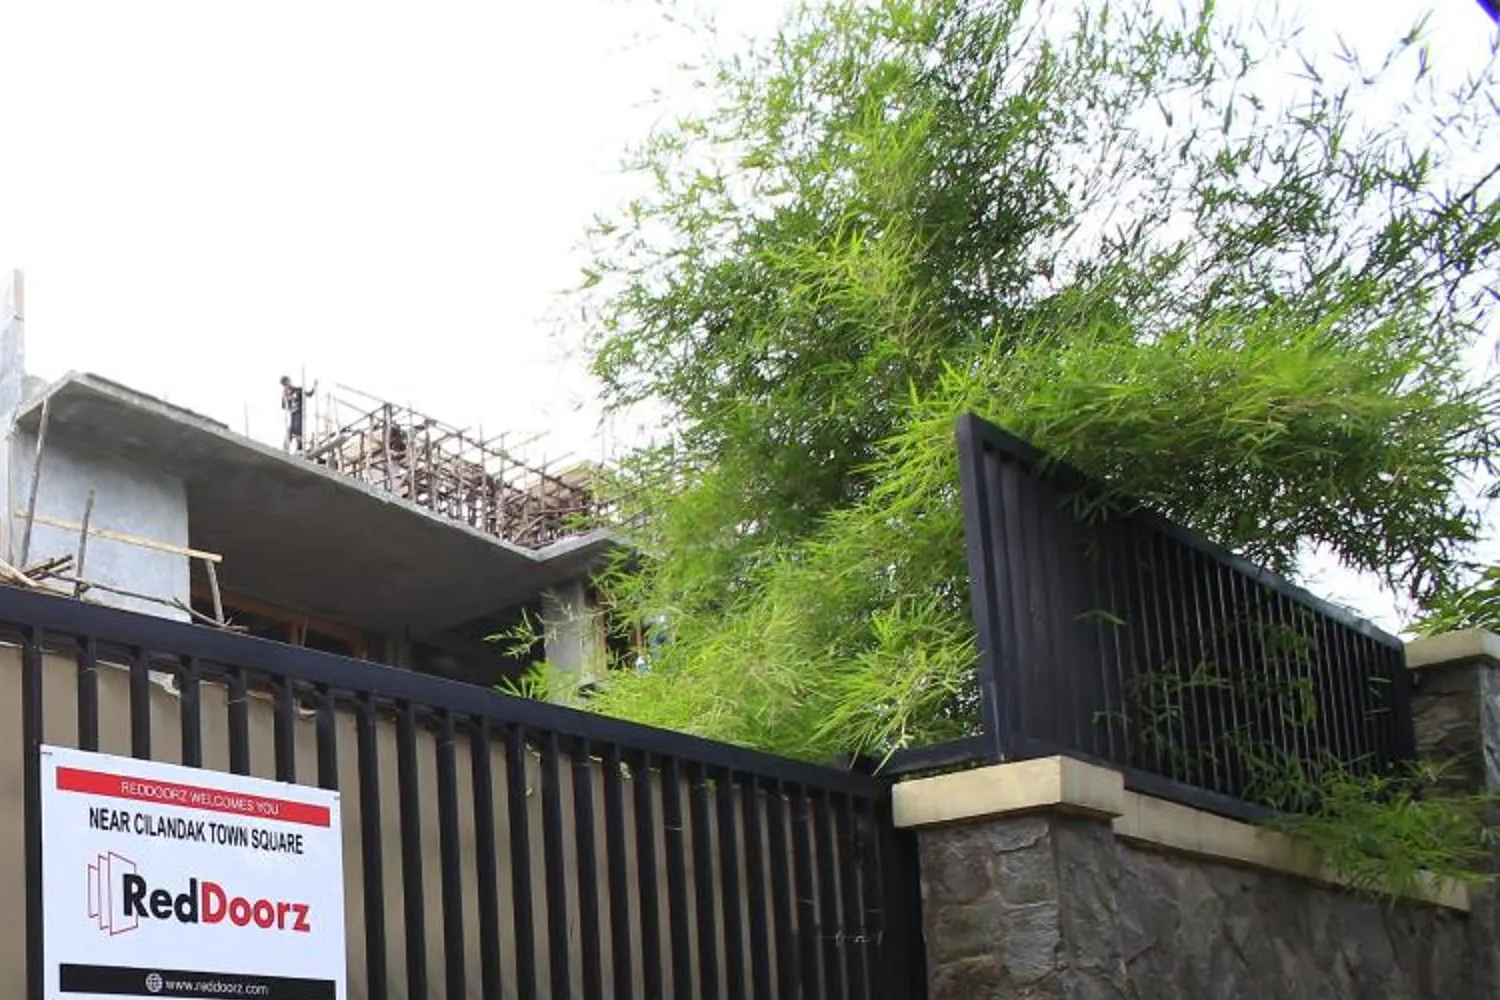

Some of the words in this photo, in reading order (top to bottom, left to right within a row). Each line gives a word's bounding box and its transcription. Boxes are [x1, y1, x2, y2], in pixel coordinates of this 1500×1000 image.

[121, 781, 187, 801] REDDOORZ
[189, 791, 255, 812] WELCOMES
[256, 800, 279, 814] YOU
[89, 807, 130, 833] NEAR
[134, 813, 206, 842] CILANDAK
[209, 823, 248, 848] TOWN
[252, 828, 304, 854] SQUARE
[123, 873, 311, 932] RedDoorz
[165, 979, 269, 996] www.reddoorz.com
